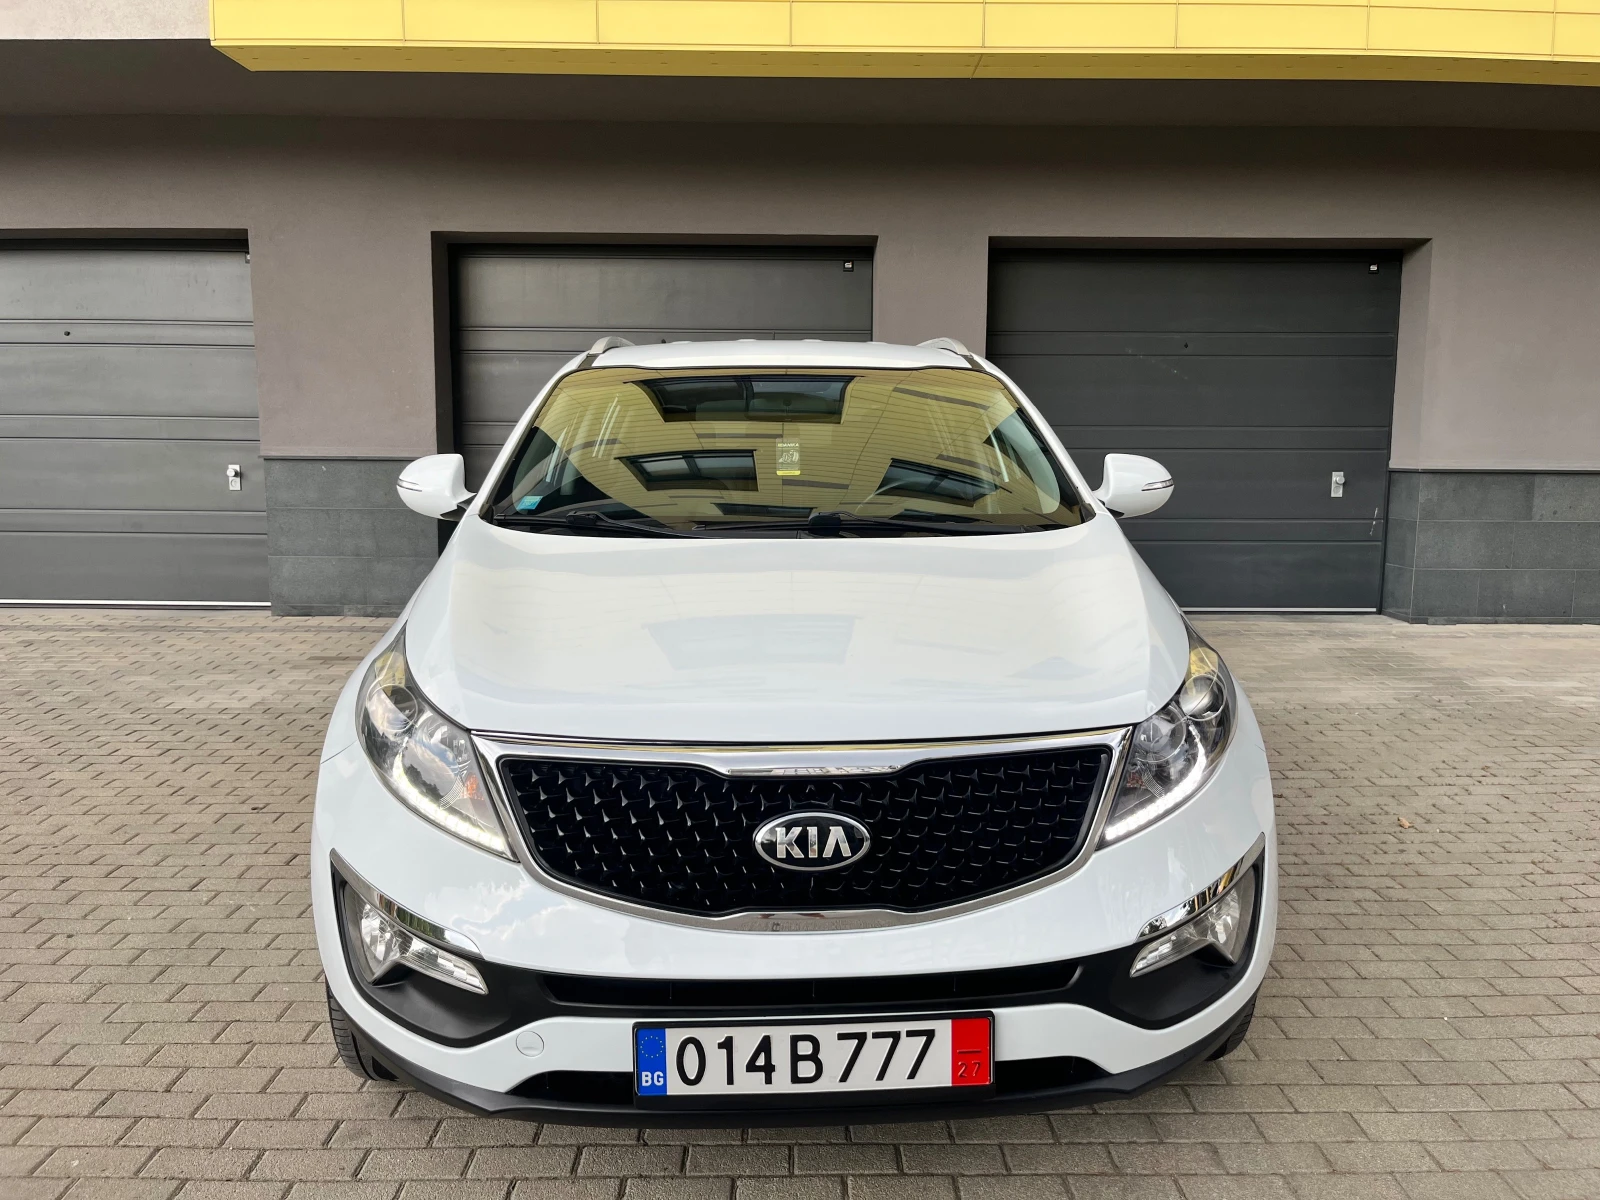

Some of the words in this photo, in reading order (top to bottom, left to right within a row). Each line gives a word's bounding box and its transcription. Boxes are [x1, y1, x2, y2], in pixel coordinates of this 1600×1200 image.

[775, 826, 852, 858] KIA
[675, 1028, 936, 1087] 014B777
[957, 1060, 981, 1078] 27
[641, 1071, 664, 1086] BG
